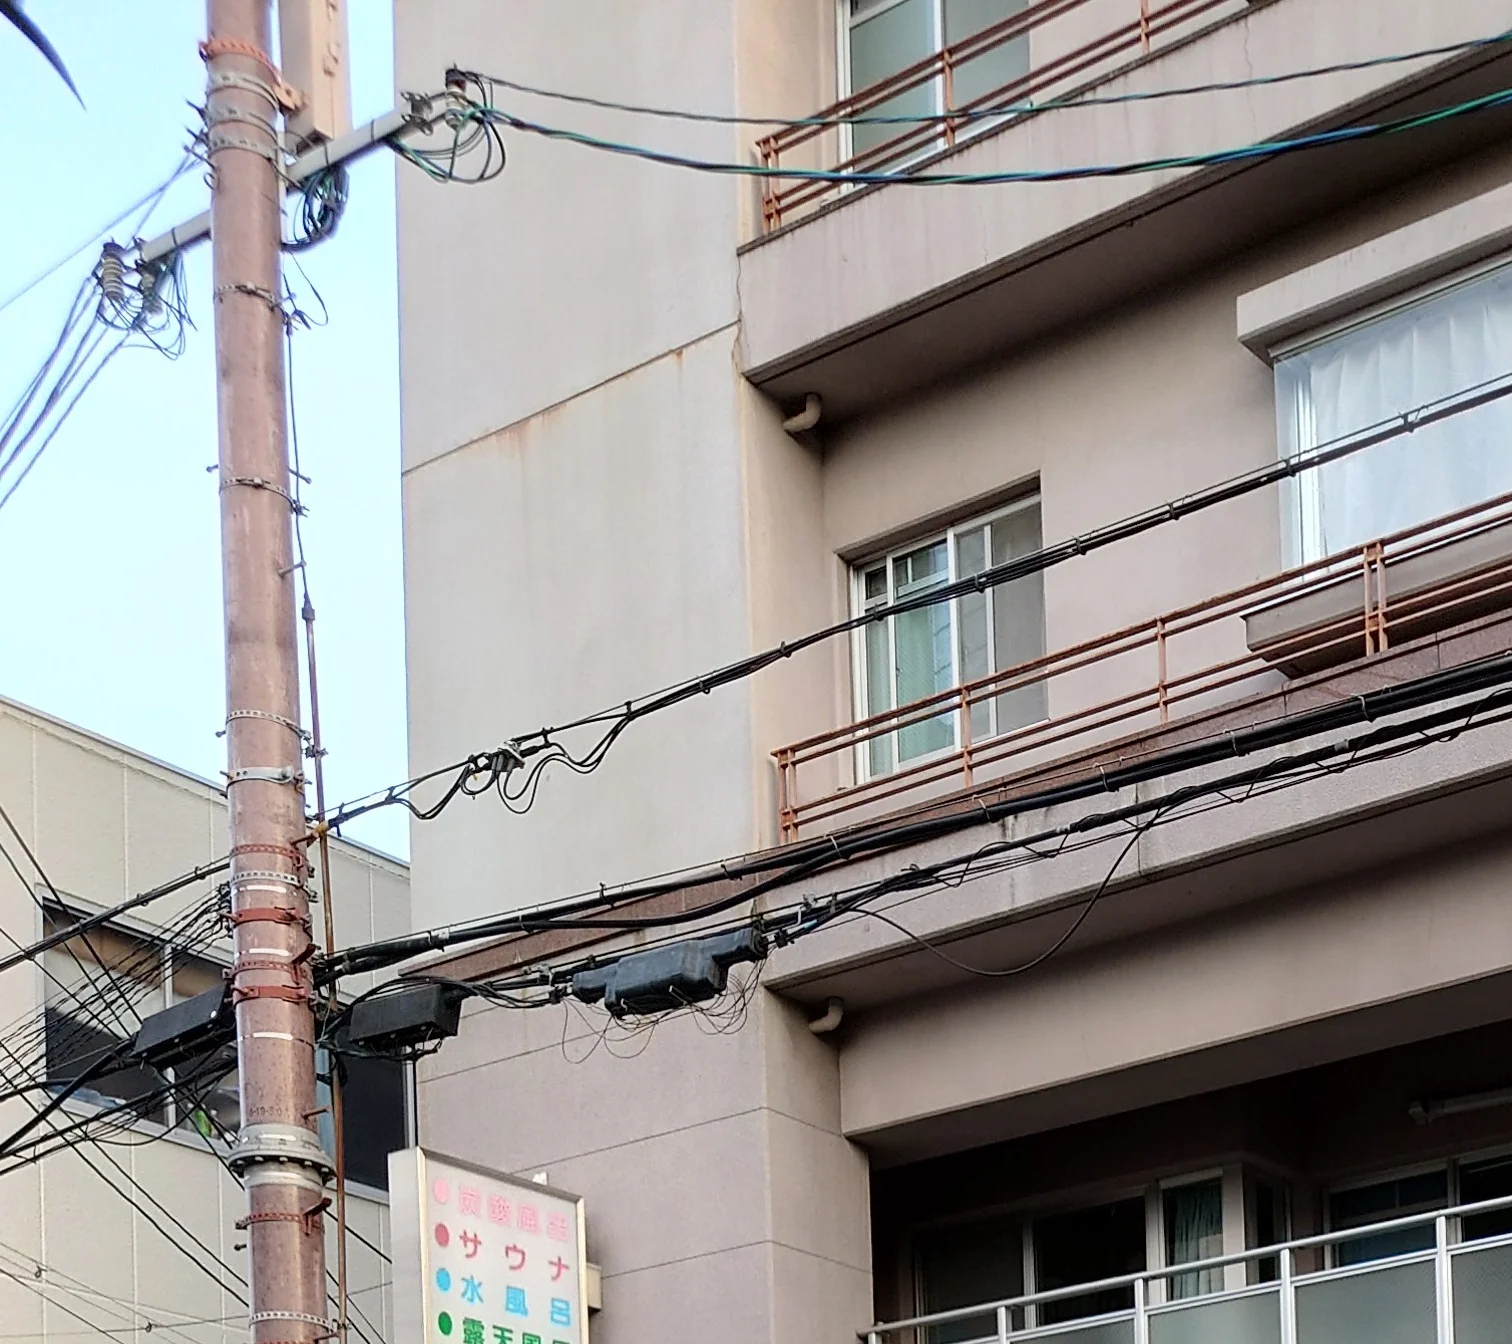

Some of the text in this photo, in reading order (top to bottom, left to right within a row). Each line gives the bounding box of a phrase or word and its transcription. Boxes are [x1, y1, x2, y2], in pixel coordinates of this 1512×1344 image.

[459, 1230, 570, 1281] サウナ
[460, 1274, 571, 1327] 水風呂
